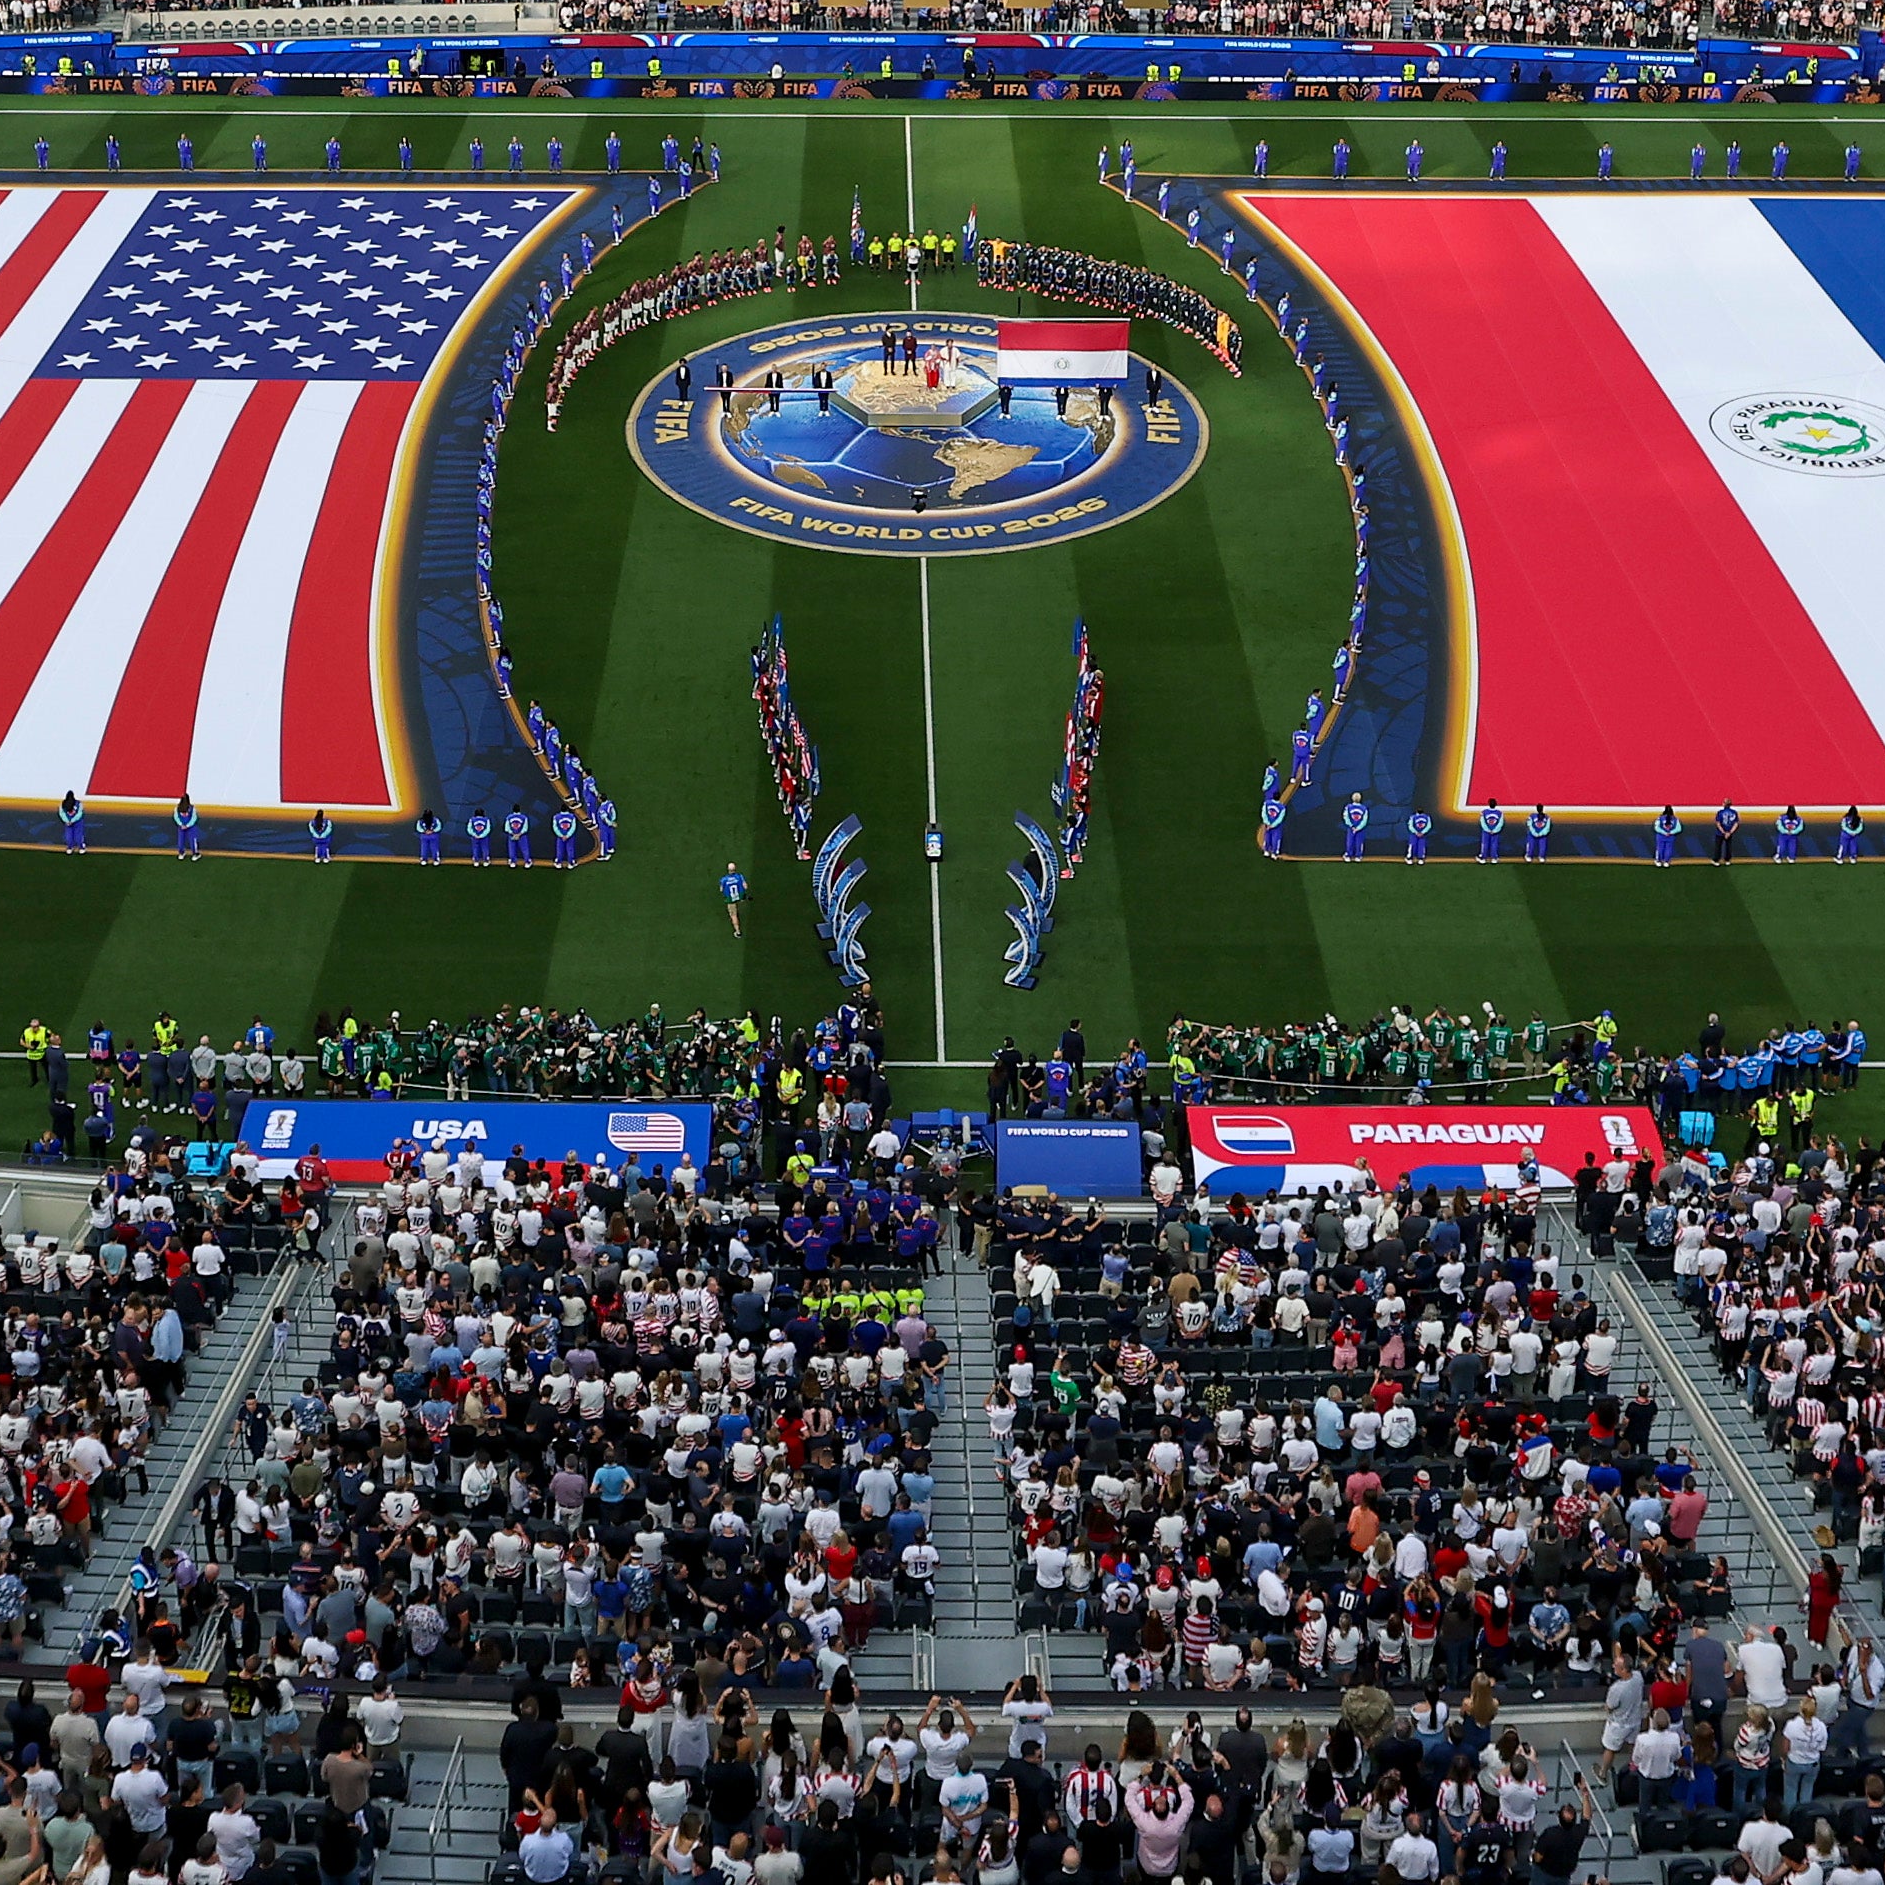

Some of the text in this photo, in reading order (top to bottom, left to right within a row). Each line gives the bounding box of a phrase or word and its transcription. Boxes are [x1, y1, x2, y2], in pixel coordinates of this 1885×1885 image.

[89, 79, 124, 91] FIFA
[182, 79, 217, 92] FIFA
[388, 80, 423, 93] FIFA
[482, 81, 517, 94] FIFA
[690, 82, 725, 95] FIFA
[783, 83, 819, 96] FIFA
[993, 83, 1029, 96] FIFA
[1295, 84, 1330, 97] FIFA
[1388, 85, 1423, 98] FIFA
[1594, 86, 1630, 100] FIFA
[1687, 87, 1723, 100] FIFA
[748, 325, 847, 356] 2026
[1734, 398, 1834, 417] PARAGUAY
[1730, 420, 1750, 438] DEL
[727, 494, 1111, 542] FIFA WORLD CUP 2026
[411, 1119, 488, 1141] USA
[1007, 1127, 1129, 1138] FIFA WORLD CUP 2026
[1349, 1124, 1546, 1146] PARAGUAY
[301, 1166, 314, 1179] 13
[413, 1216, 425, 1227] 10
[495, 1222, 508, 1234] 10
[19, 1257, 32, 1269] 10
[631, 1300, 641, 1312] 17
[660, 1304, 670, 1315] 10
[687, 1300, 696, 1311] 10
[775, 1387, 787, 1401] 10
[394, 1502, 404, 1518] 2
[914, 1561, 927, 1574] 19
[821, 1626, 830, 1641] 8
